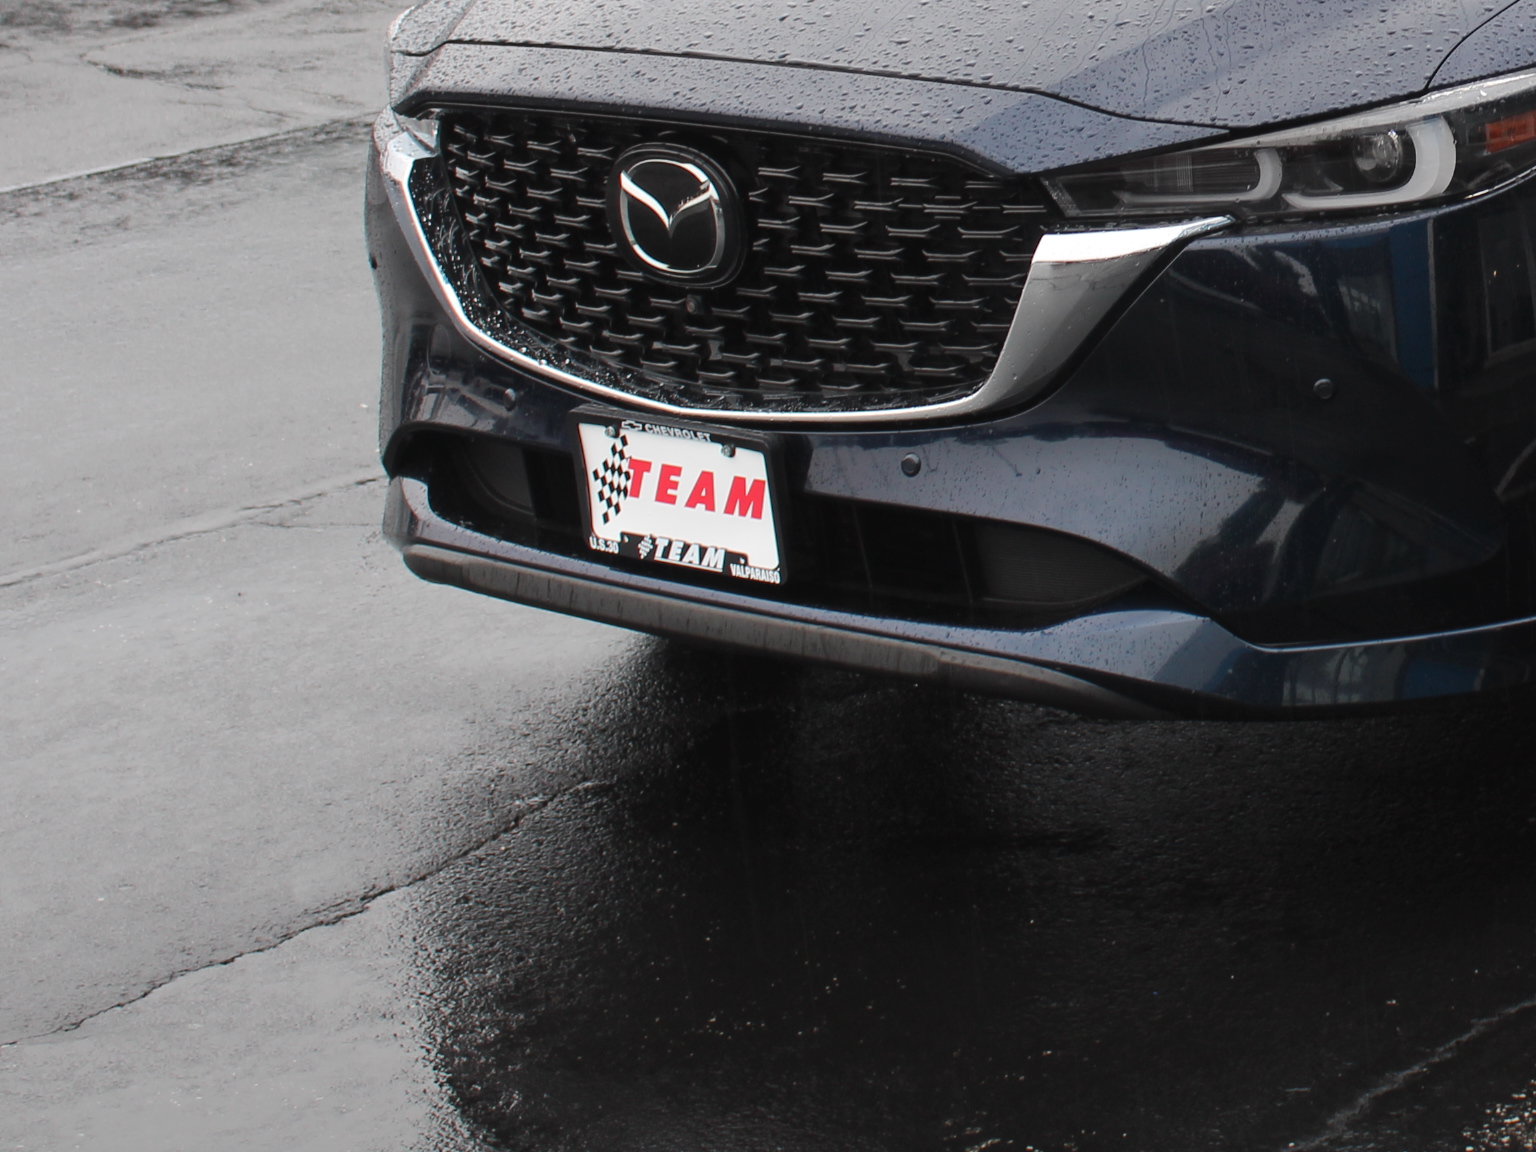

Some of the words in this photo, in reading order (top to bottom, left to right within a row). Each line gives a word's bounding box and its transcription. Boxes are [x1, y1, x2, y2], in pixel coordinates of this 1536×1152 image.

[645, 423, 712, 442] CHEVROLET
[628, 458, 766, 520] TEAM
[654, 537, 725, 569] TEAM
[730, 563, 781, 585] VALPARAISO
